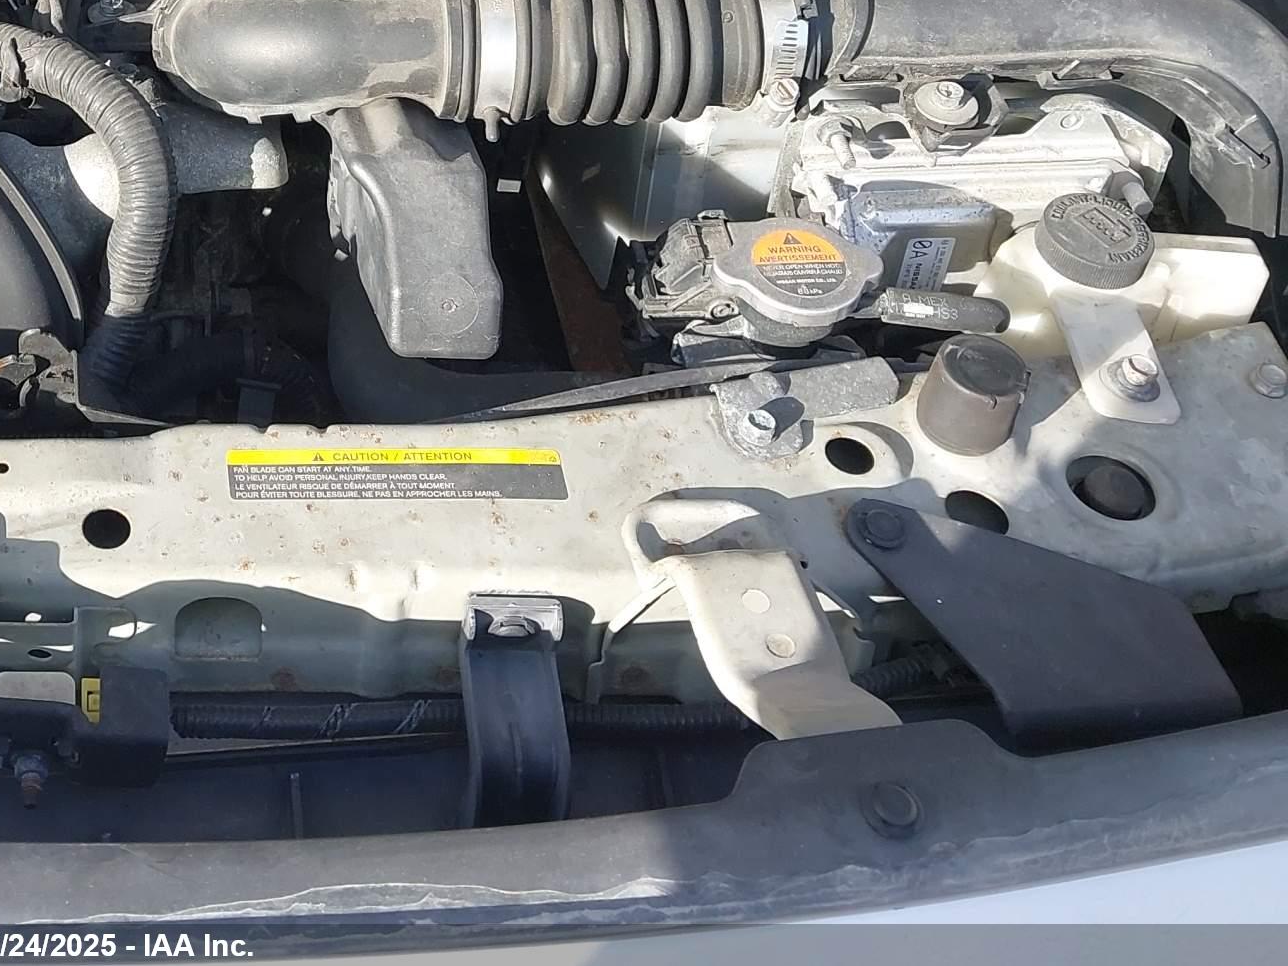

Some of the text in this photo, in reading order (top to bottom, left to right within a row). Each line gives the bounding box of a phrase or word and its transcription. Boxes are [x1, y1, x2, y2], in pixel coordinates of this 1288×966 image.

[767, 245, 822, 254] WARNING
[759, 254, 837, 263] AVERTISSEMENT
[332, 452, 389, 461] CAUTION
[403, 451, 473, 461] ATTENTION
[233, 466, 249, 474] FAN
[250, 466, 277, 474] BLADE
[296, 465, 321, 473] START
[323, 465, 333, 473] AT
[234, 474, 246, 482] TO
[246, 474, 268, 482] HELP
[268, 474, 293, 482] AVOID
[294, 474, 339, 482] PERSONAL
[388, 473, 418, 481] HANDS
[418, 473, 448, 481] CLEAR.
[234, 483, 245, 491] LE
[245, 483, 298, 491] VENTILATEUR
[298, 483, 331, 491] RISQUE
[343, 481, 388, 490] DÉMARRER
[389, 481, 396, 490] À
[396, 482, 418, 490] TOUT
[235, 491, 259, 499] POUR
[260, 489, 288, 499] ÉVITER
[288, 491, 316, 499] TOUTE
[405, 490, 457, 498] APPROCHER
[457, 490, 473, 498] LES
[474, 490, 503, 498] MAINS.
